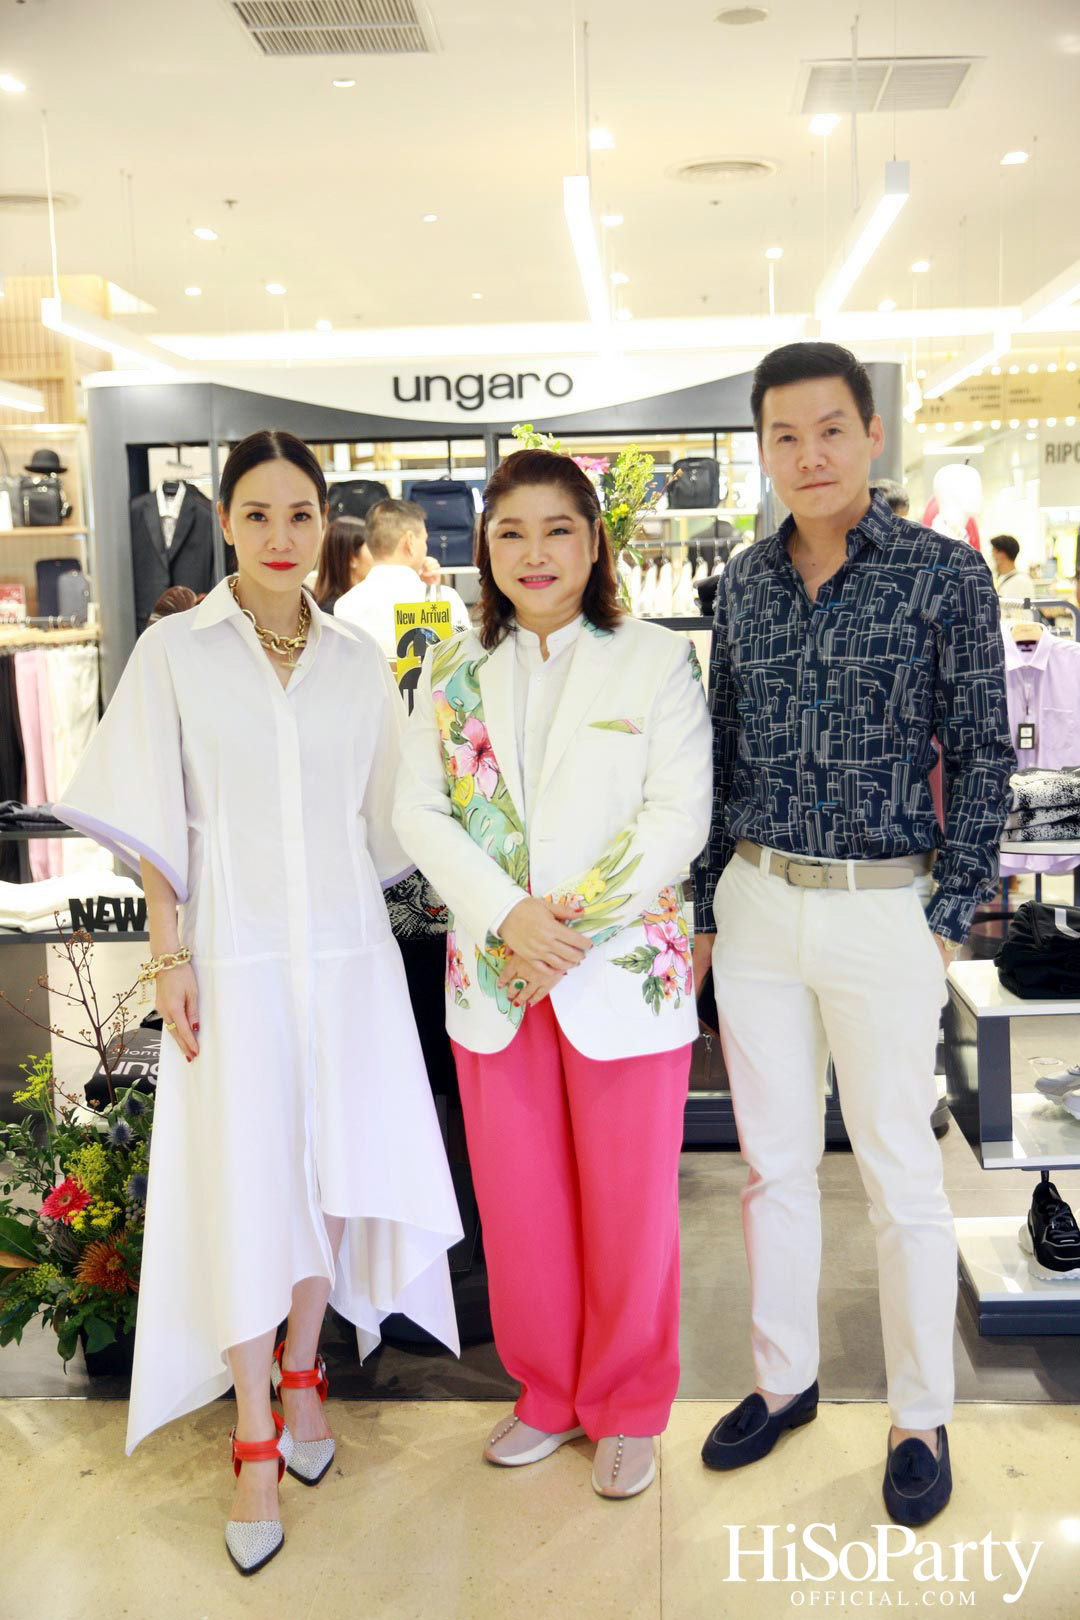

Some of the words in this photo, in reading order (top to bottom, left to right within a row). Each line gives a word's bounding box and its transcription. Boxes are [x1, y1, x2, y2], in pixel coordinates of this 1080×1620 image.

[393, 371, 574, 411] ungaro
[396, 610, 416, 625] New
[420, 605, 450, 624] Arrival
[68, 895, 147, 932] NEW
